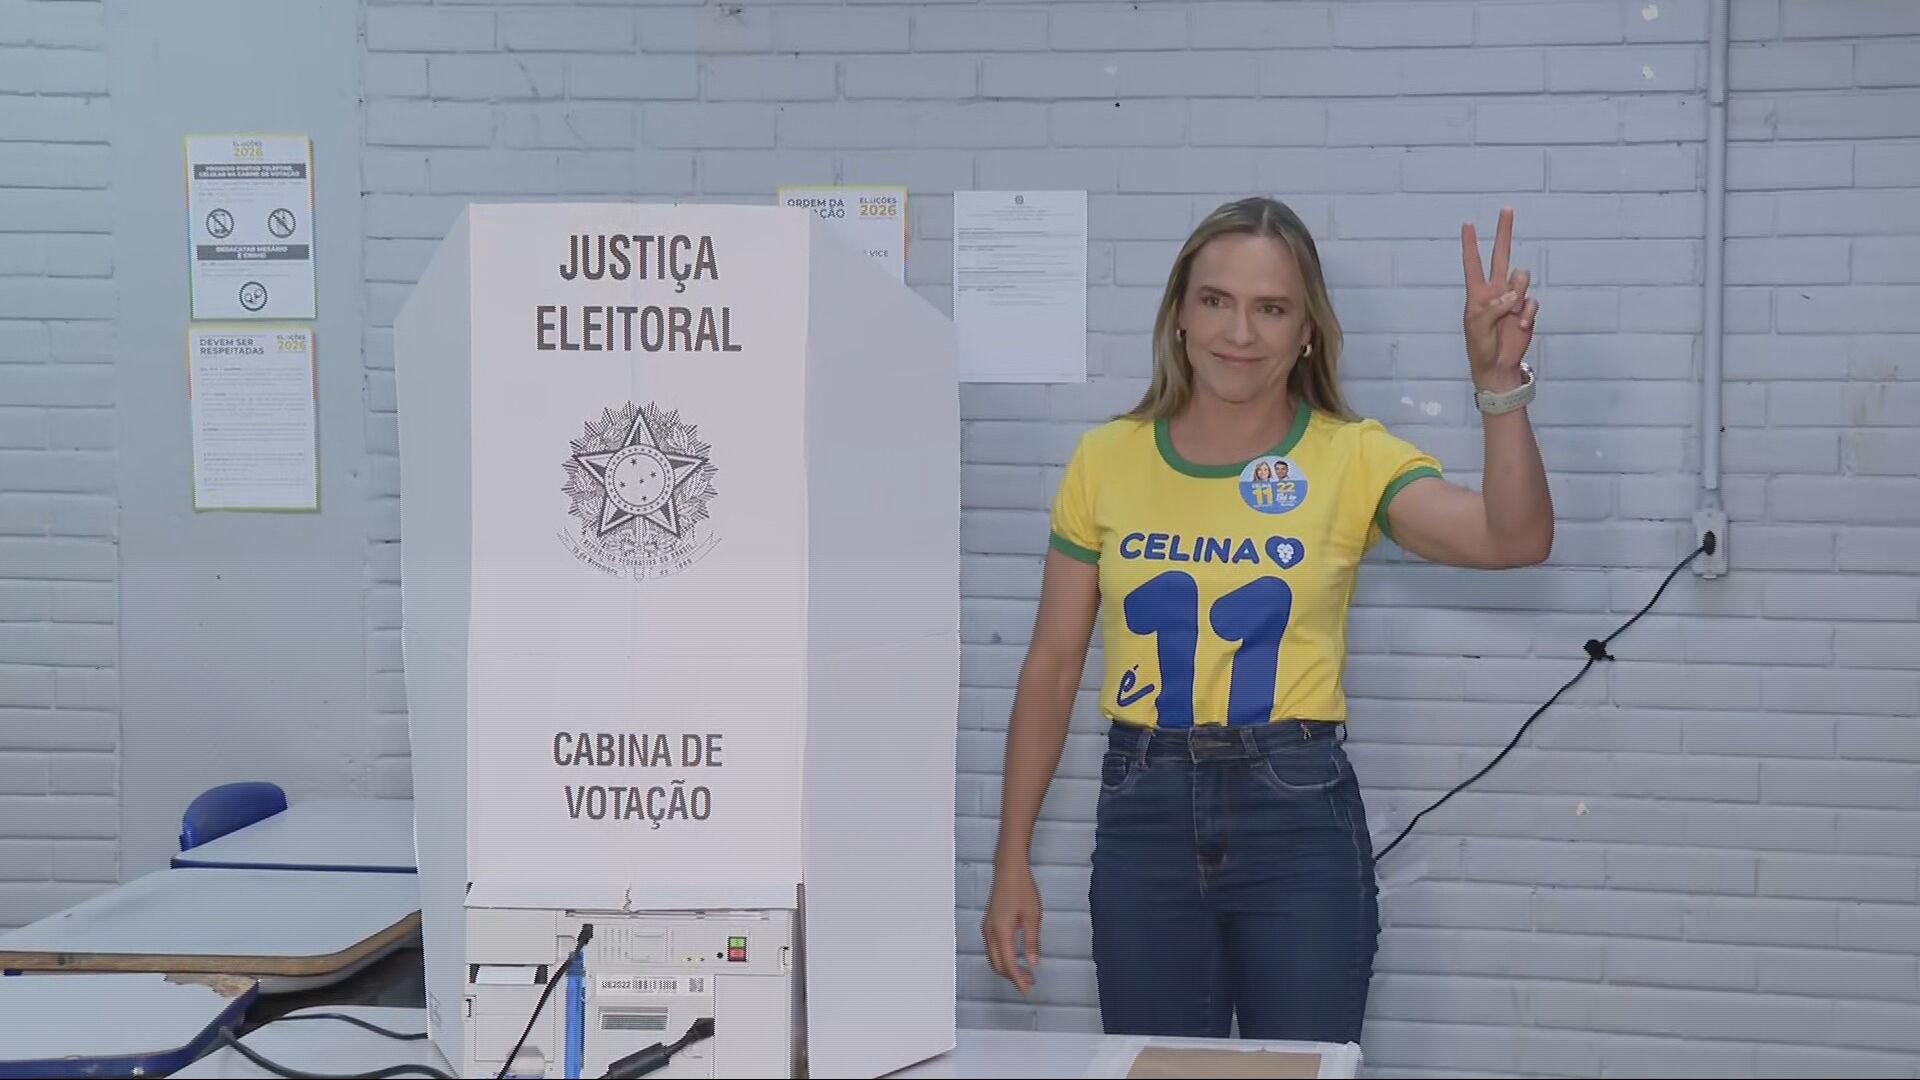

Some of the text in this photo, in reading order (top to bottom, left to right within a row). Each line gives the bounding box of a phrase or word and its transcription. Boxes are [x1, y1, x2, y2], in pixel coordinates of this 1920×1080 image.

[786, 198, 845, 208] ORDEM DA
[860, 204, 897, 216] 2026
[559, 234, 719, 293] JUSTIÇA
[536, 305, 743, 352] ELEITORAL
[199, 338, 255, 346] DEVEM SER
[199, 346, 265, 355] RESPEITADAS
[1252, 487, 1273, 505] 11
[1276, 482, 1296, 493] 22
[1120, 532, 1260, 564] CELINA
[1123, 570, 1293, 729] 11
[553, 731, 723, 767] CABINA DE
[564, 778, 712, 830] VOTAÇÃO
[601, 980, 632, 989] UE2022
